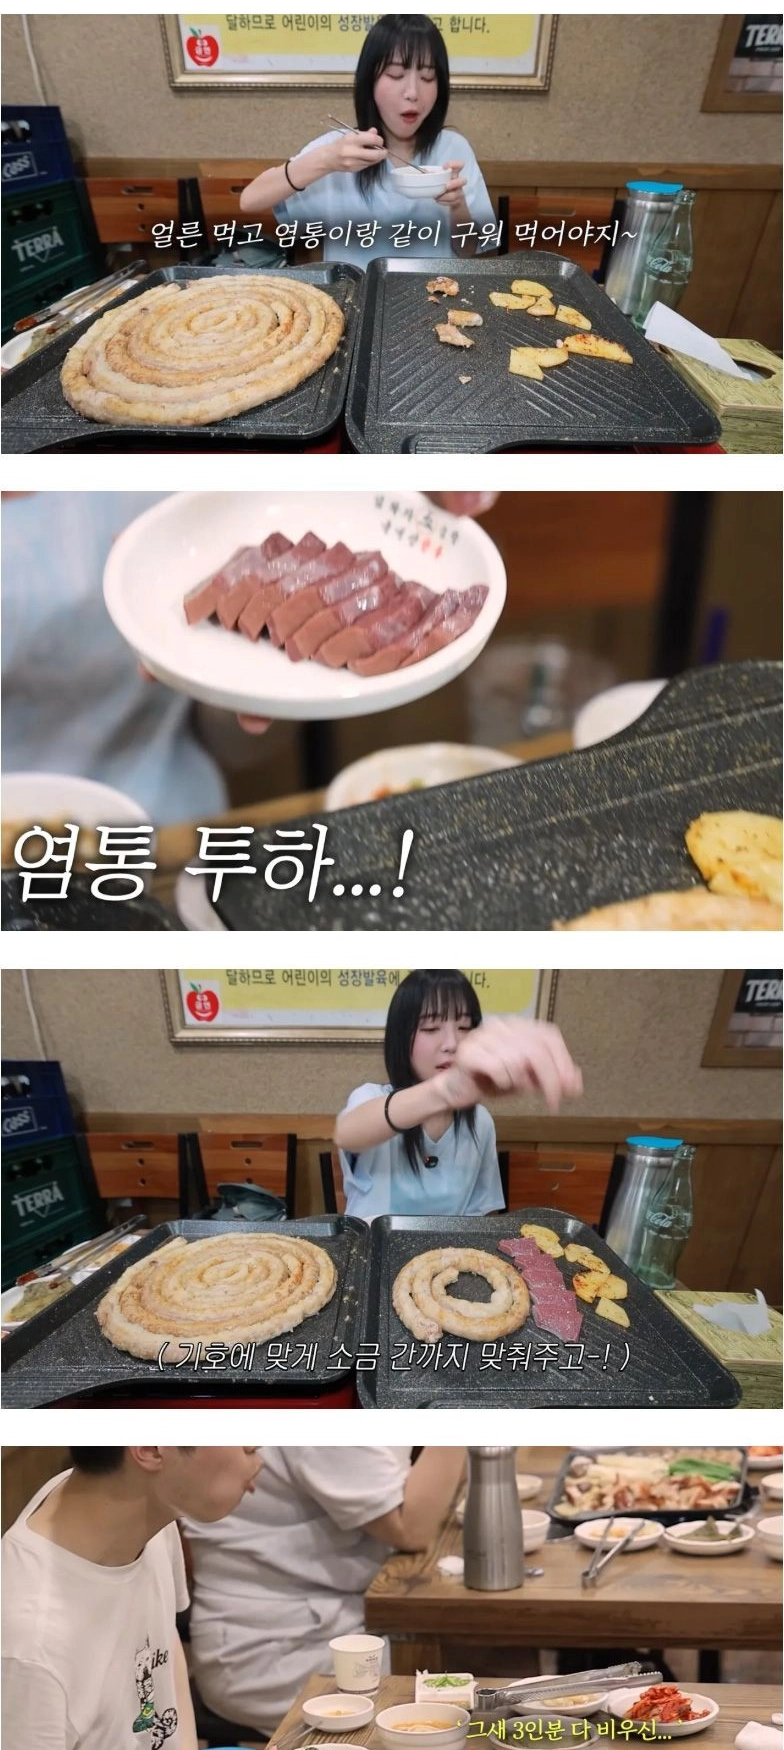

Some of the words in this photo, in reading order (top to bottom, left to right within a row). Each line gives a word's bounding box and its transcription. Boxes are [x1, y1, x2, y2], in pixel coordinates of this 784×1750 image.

[225, 14, 276, 31] 달하므로
[281, 14, 332, 31] 어린이의
[11, 226, 64, 262] TERRA
[281, 969, 332, 986] 어린이의
[11, 1181, 64, 1217] TERRA
